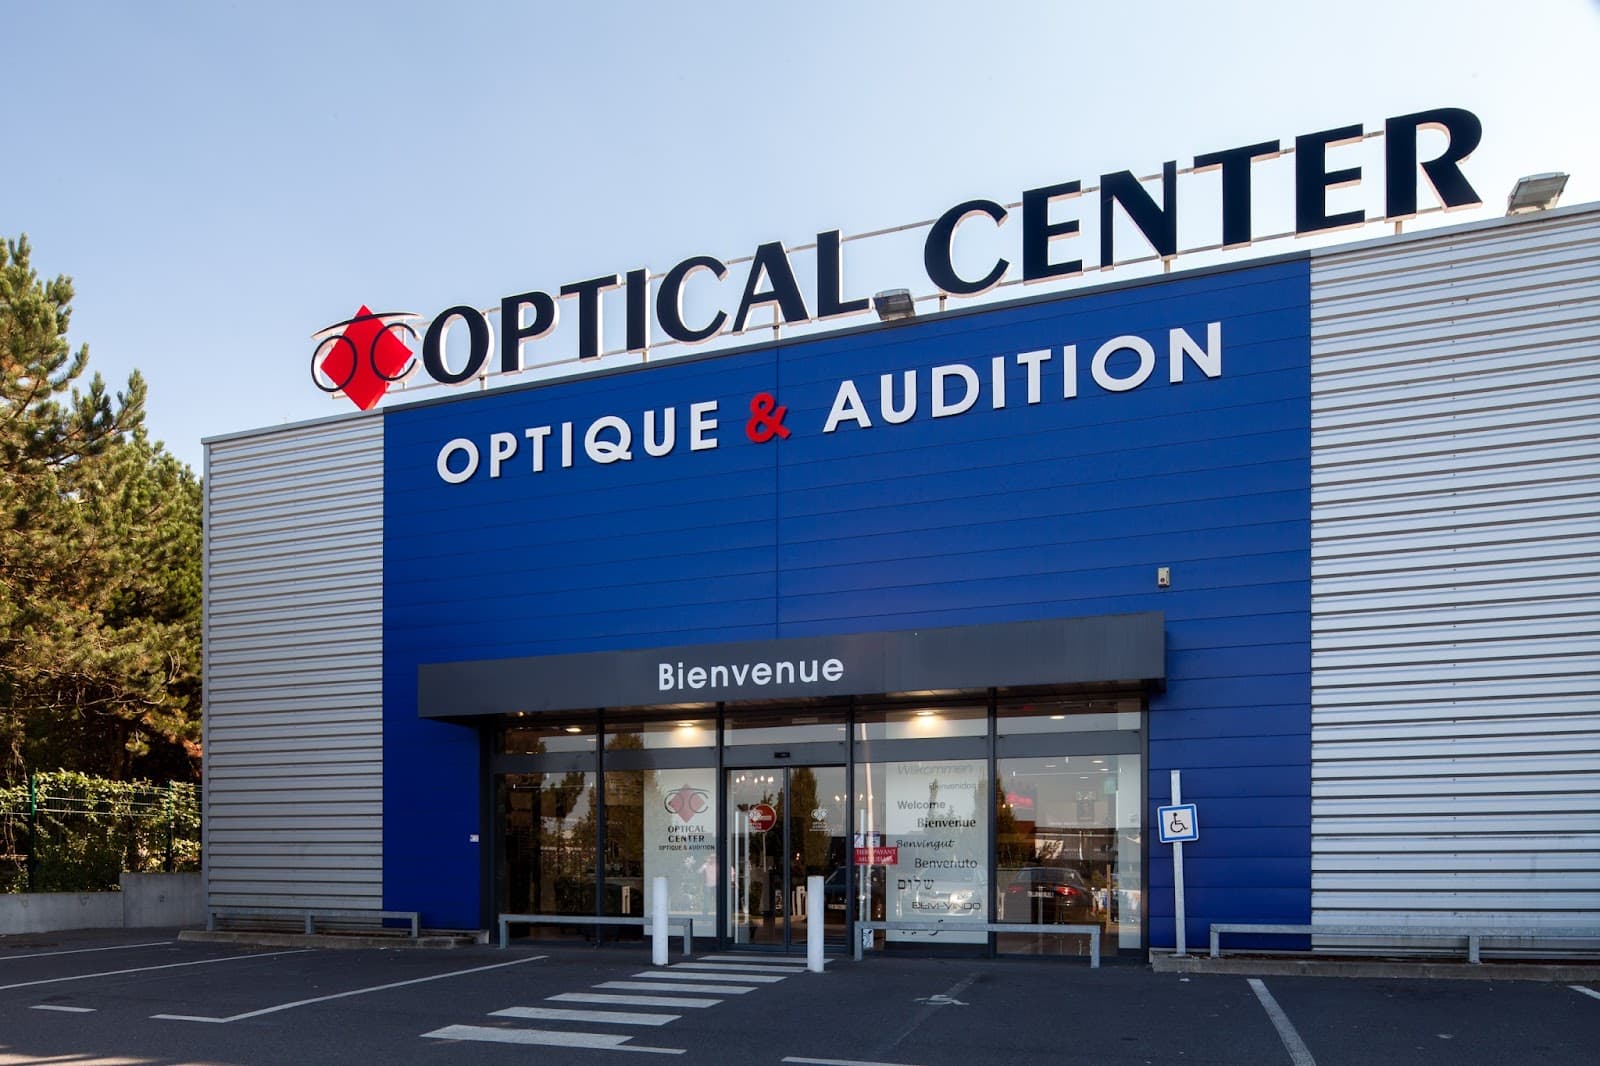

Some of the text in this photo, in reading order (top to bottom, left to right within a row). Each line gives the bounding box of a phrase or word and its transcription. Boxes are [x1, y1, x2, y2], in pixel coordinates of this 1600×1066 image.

[423, 229, 871, 386] OPTICAL
[924, 107, 1483, 297] CENTER
[436, 322, 1222, 484] OPTIQUE & AUDITION
[659, 658, 844, 691] Bienvenue
[897, 800, 945, 809] Welcome
[917, 817, 976, 828] Bienvenue
[667, 825, 705, 834] OPTICAL
[667, 835, 705, 843] CENTER
[896, 839, 955, 850] Benvingut
[914, 857, 977, 869] Benvenuto
[897, 875, 934, 890] שלום
[911, 901, 981, 910] BEM-VINDO
